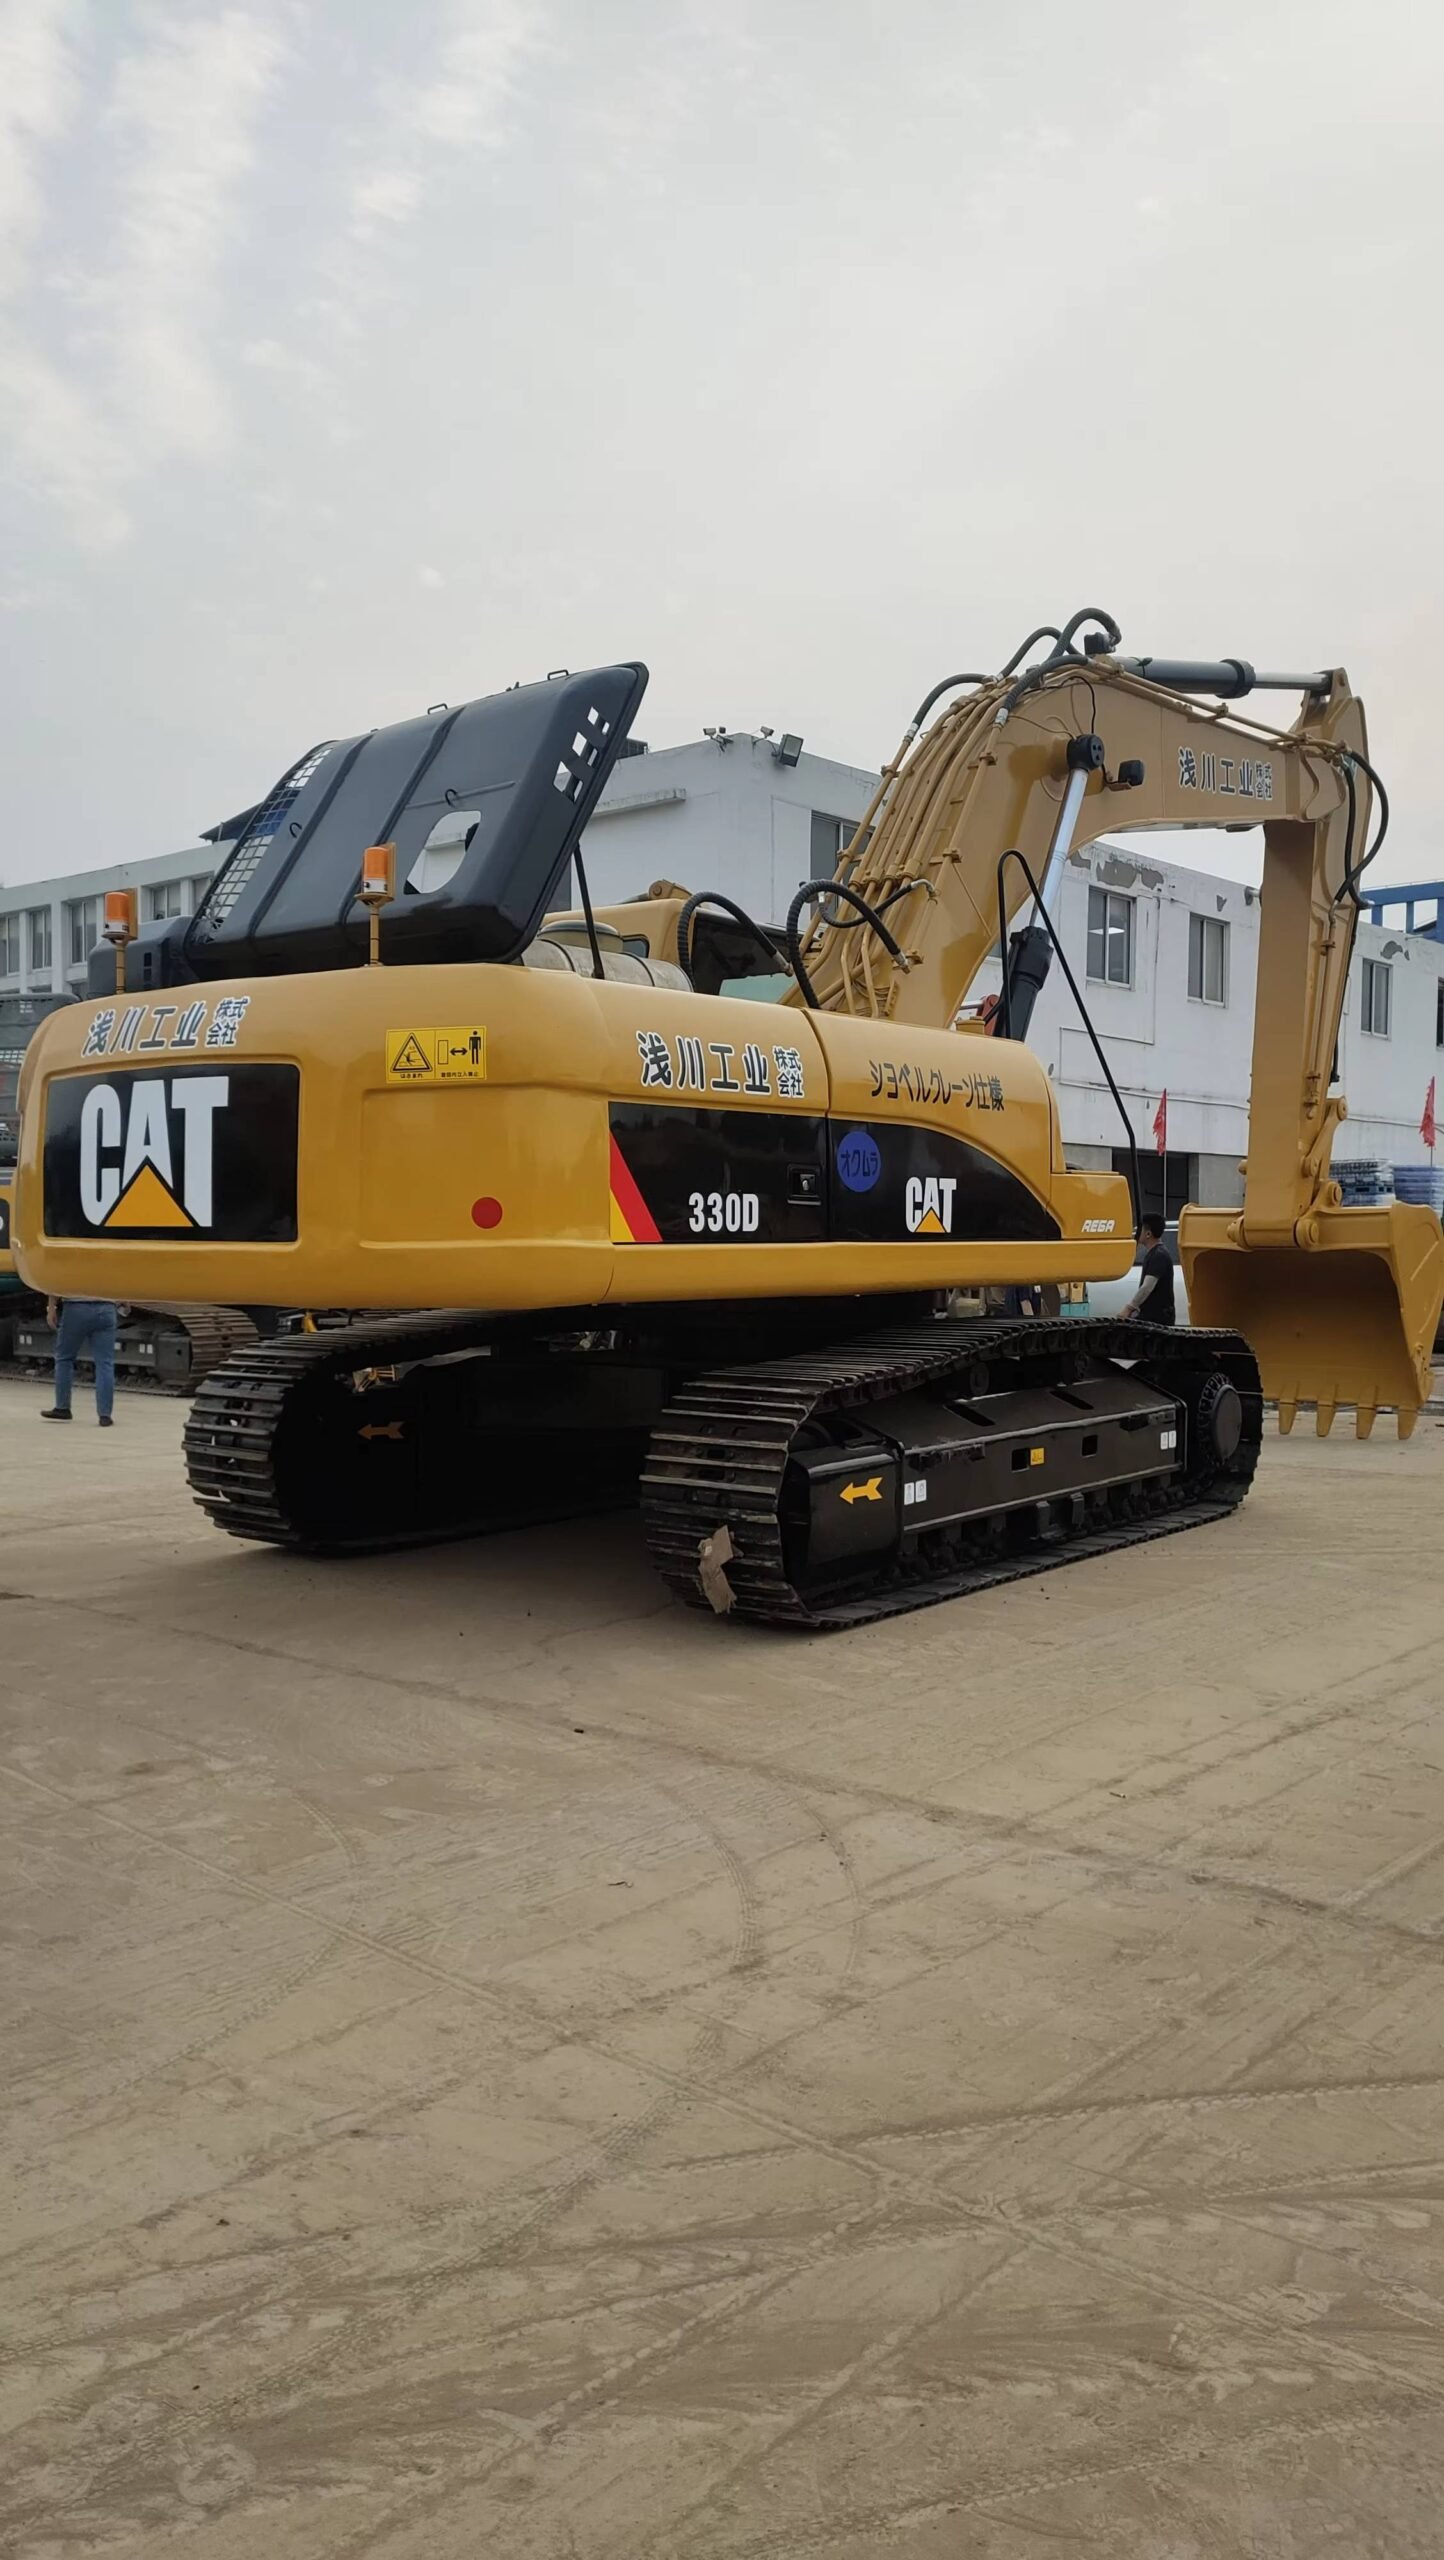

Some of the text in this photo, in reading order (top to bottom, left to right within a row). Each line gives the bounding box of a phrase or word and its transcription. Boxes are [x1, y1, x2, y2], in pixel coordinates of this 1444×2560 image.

[80, 1076, 229, 1227] CAT
[840, 1149, 879, 1177] オクムラ
[688, 1192, 759, 1233] 330D
[905, 1177, 957, 1233] CAT
